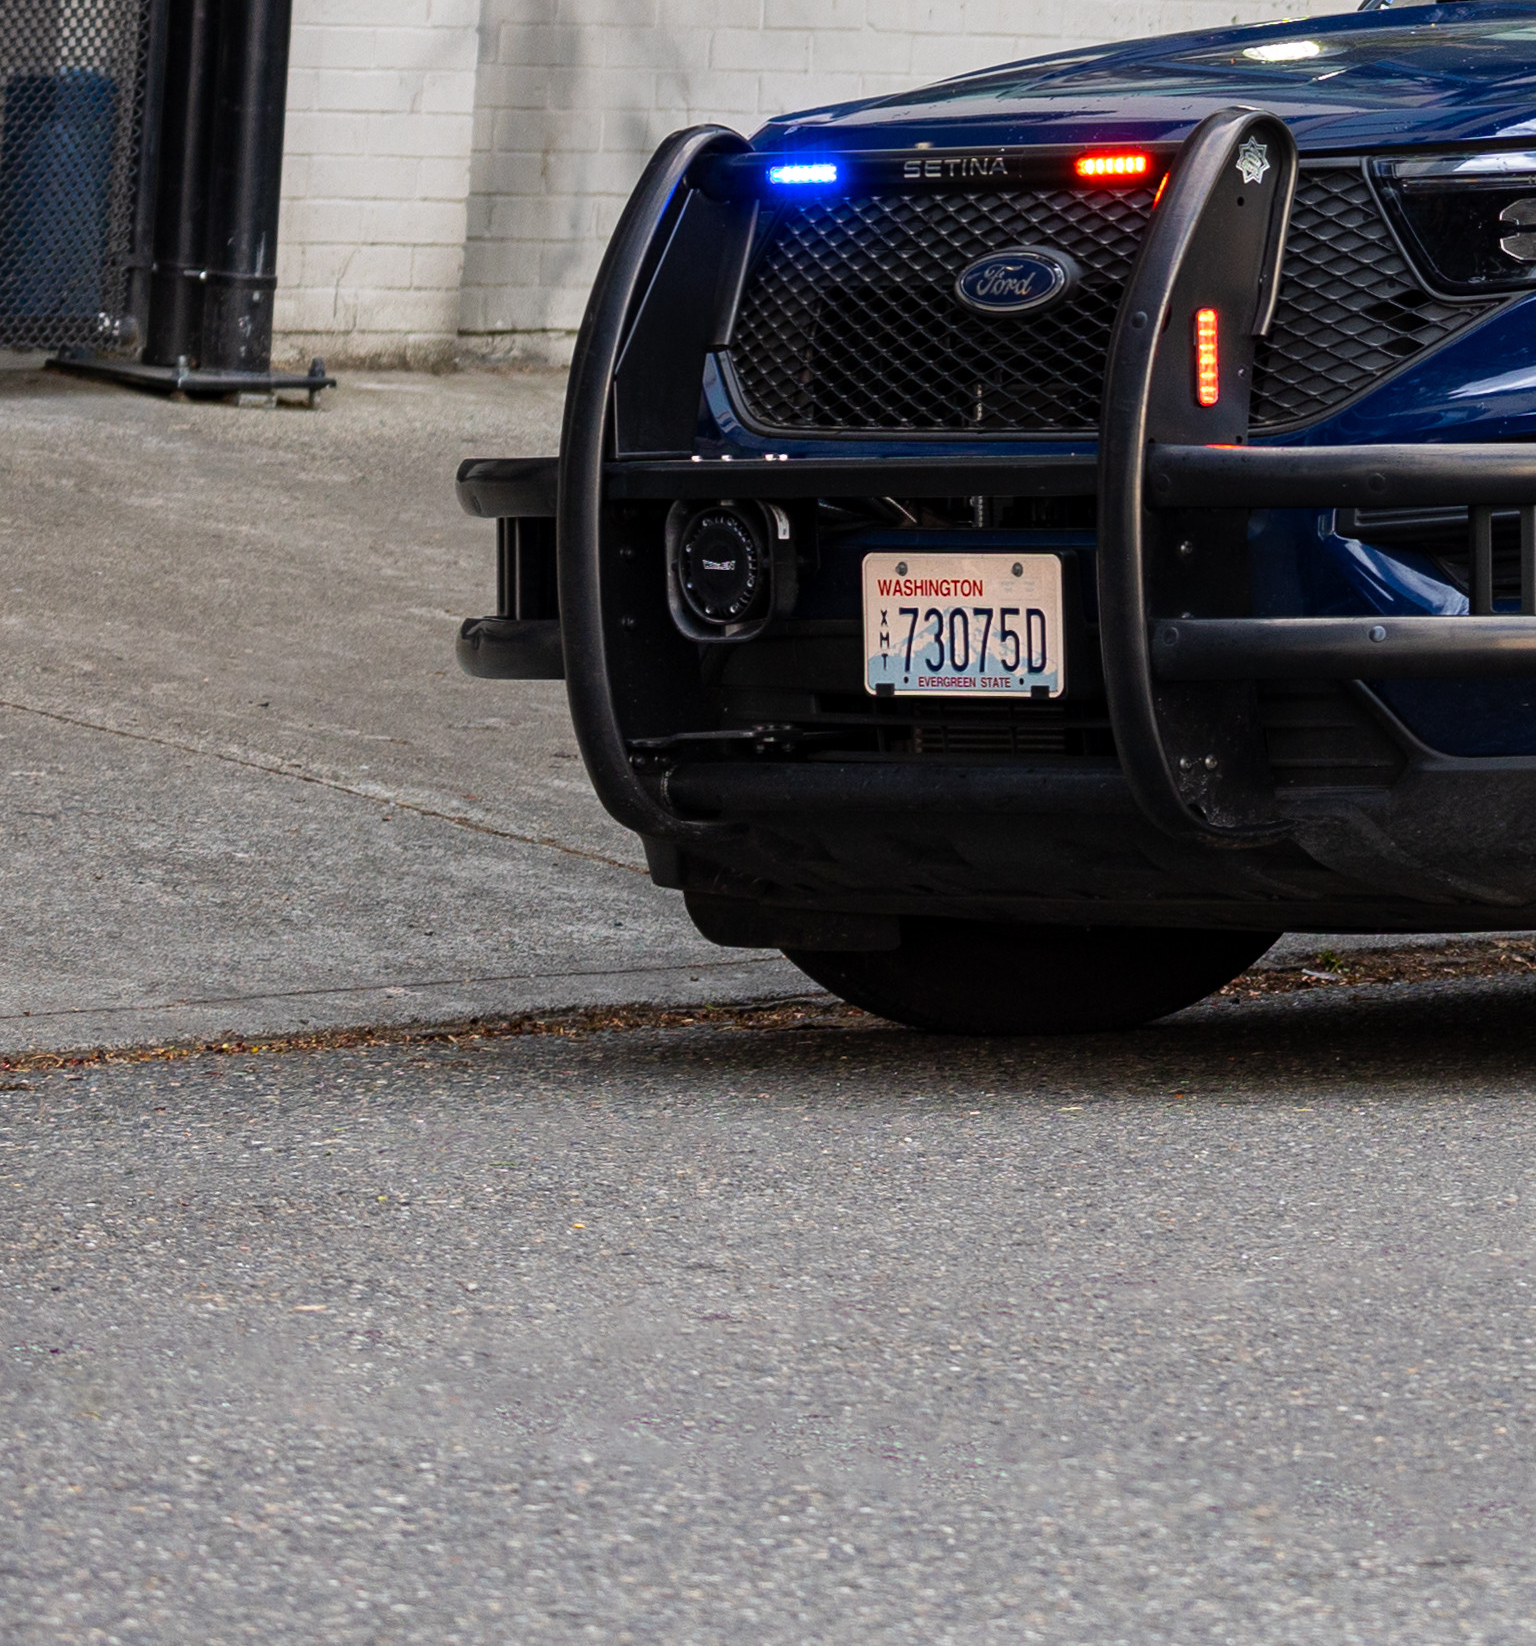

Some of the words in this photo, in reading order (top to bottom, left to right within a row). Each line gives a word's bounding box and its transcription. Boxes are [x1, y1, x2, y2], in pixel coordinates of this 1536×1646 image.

[903, 156, 1009, 180] SETINA
[976, 263, 1036, 296] Ford
[877, 579, 984, 597] WASHINGTON
[898, 606, 1047, 673] 73075D
[918, 676, 976, 688] EVERGREEN
[980, 676, 1011, 688] STATE
